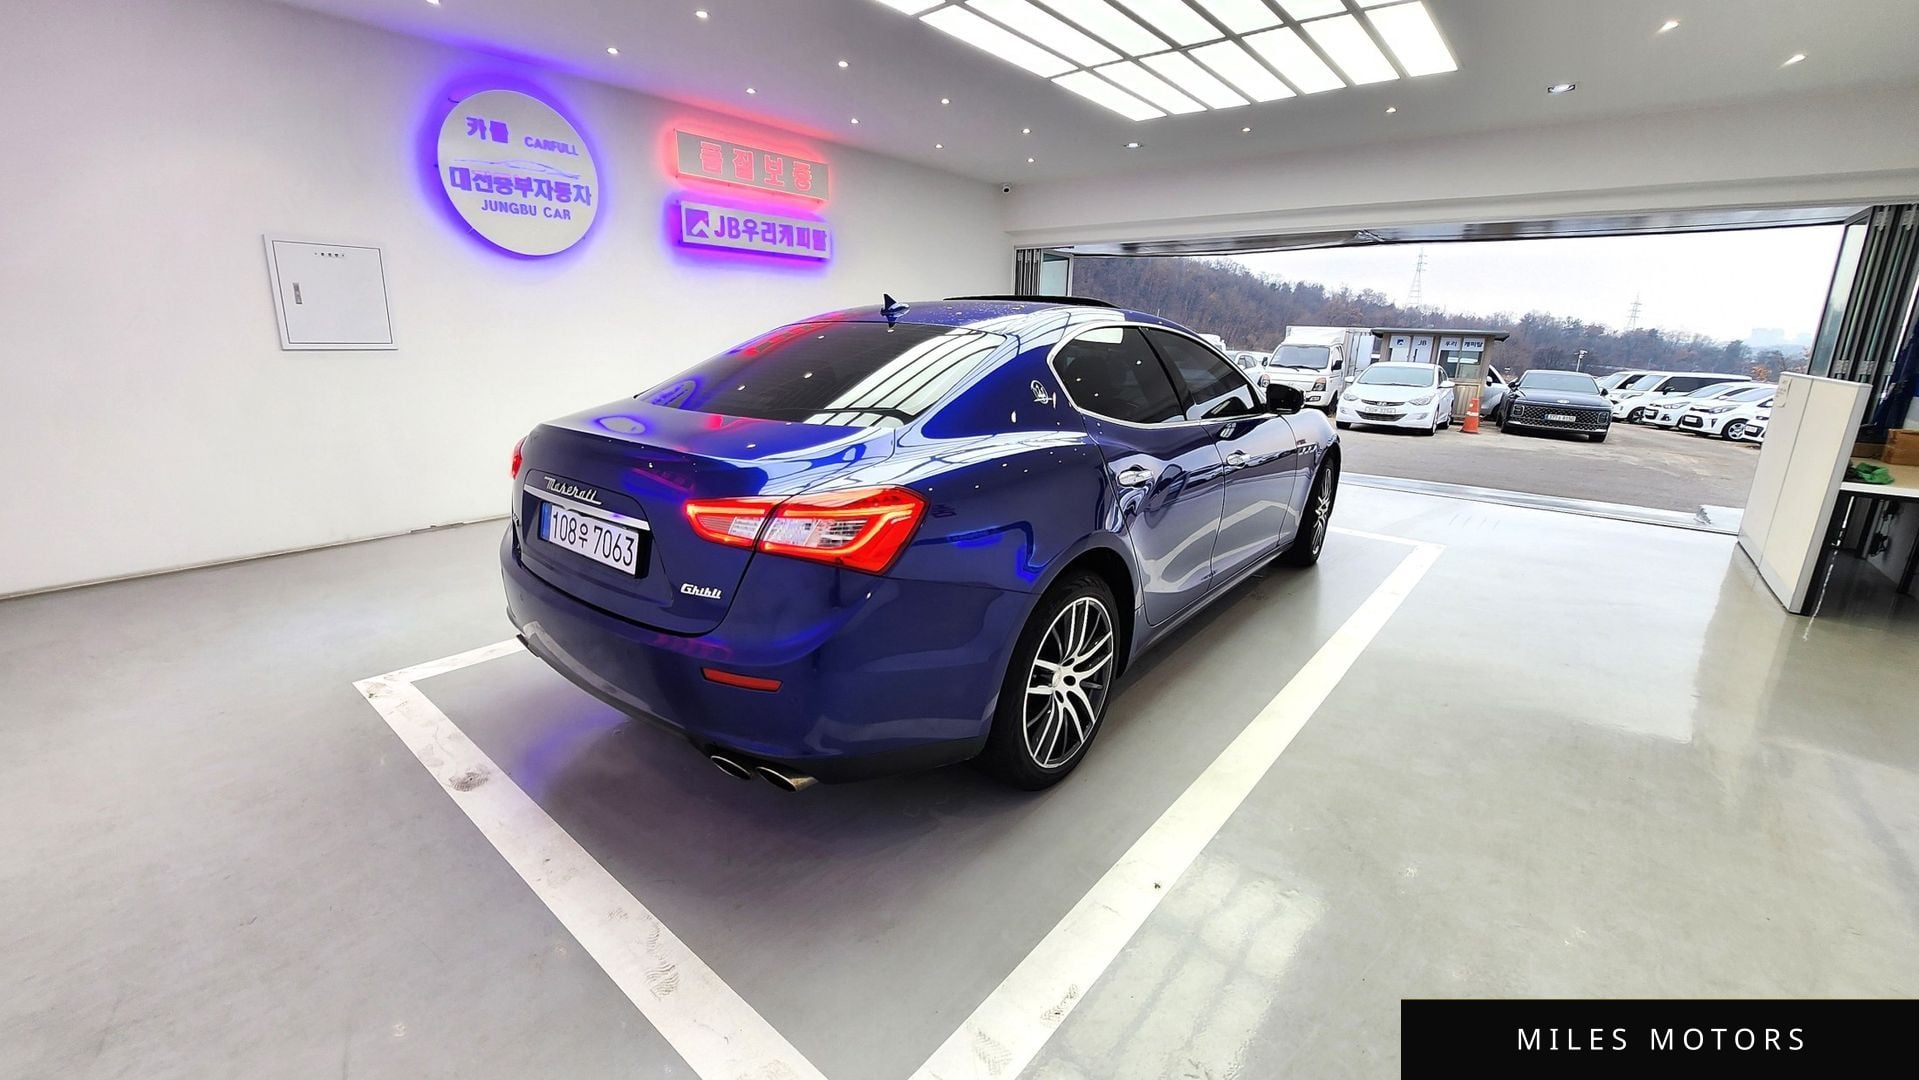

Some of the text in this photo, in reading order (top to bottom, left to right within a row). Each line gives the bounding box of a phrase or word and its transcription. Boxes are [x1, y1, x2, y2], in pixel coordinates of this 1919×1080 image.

[524, 136, 579, 156] CARFULL
[481, 199, 571, 220] JUNGBU CAR
[544, 476, 602, 505] Maserati
[553, 511, 635, 567] 108우 7063
[680, 582, 722, 600] Ghibli
